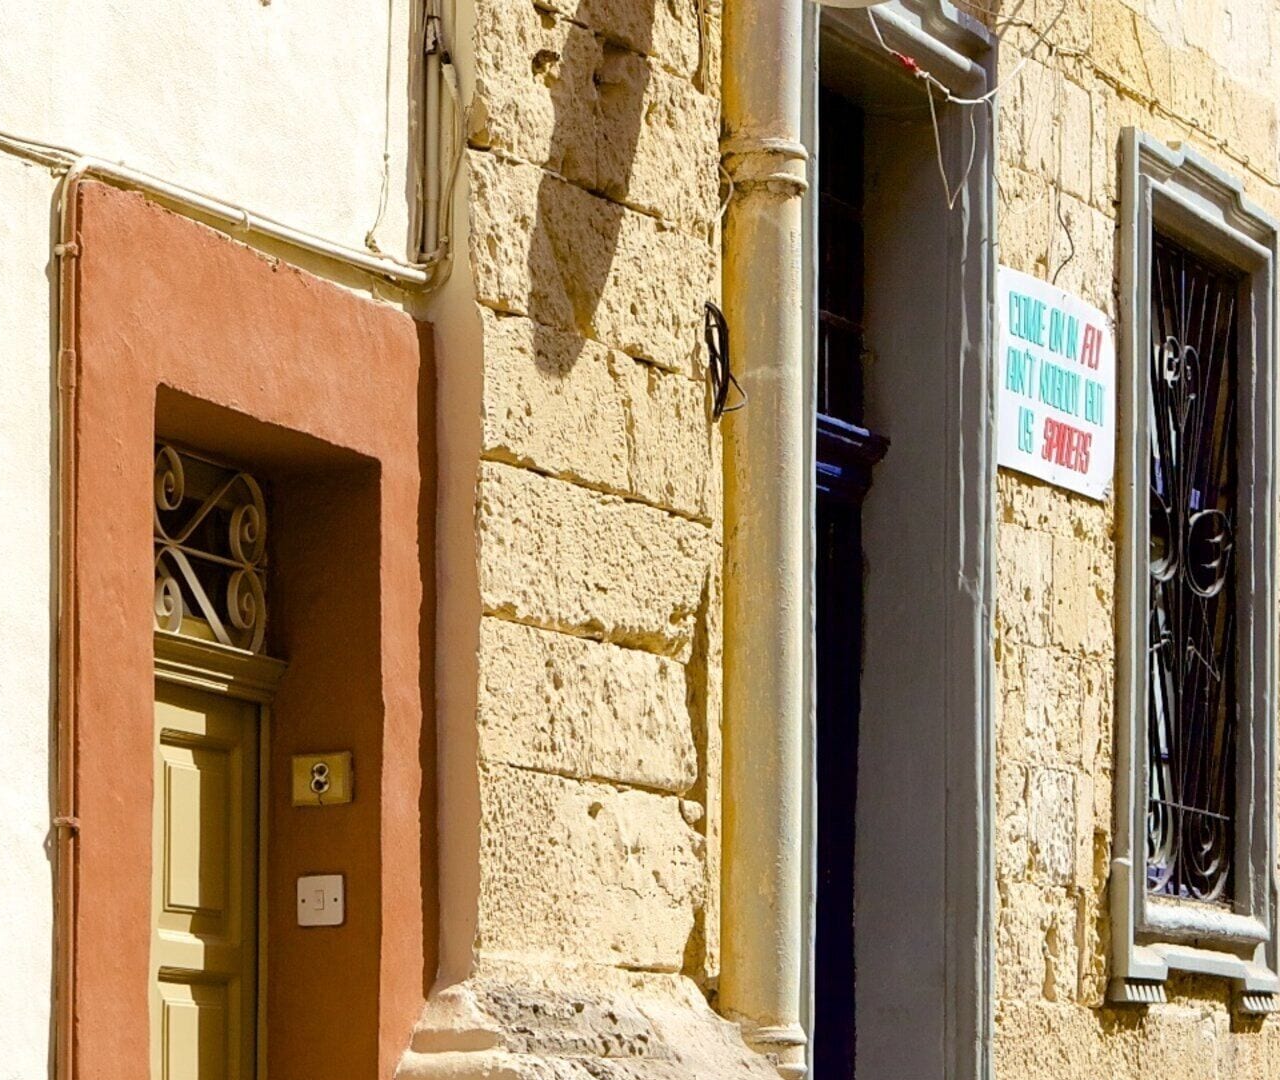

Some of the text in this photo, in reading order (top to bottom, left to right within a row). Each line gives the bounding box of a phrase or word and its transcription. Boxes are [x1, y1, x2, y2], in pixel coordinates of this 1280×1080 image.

[1009, 291, 1102, 370] COME ON IN FLY
[1006, 346, 1105, 426] AIN'T NOBODY BUT
[1017, 406, 1092, 474] US SPIDERS
[311, 763, 330, 793] 8
